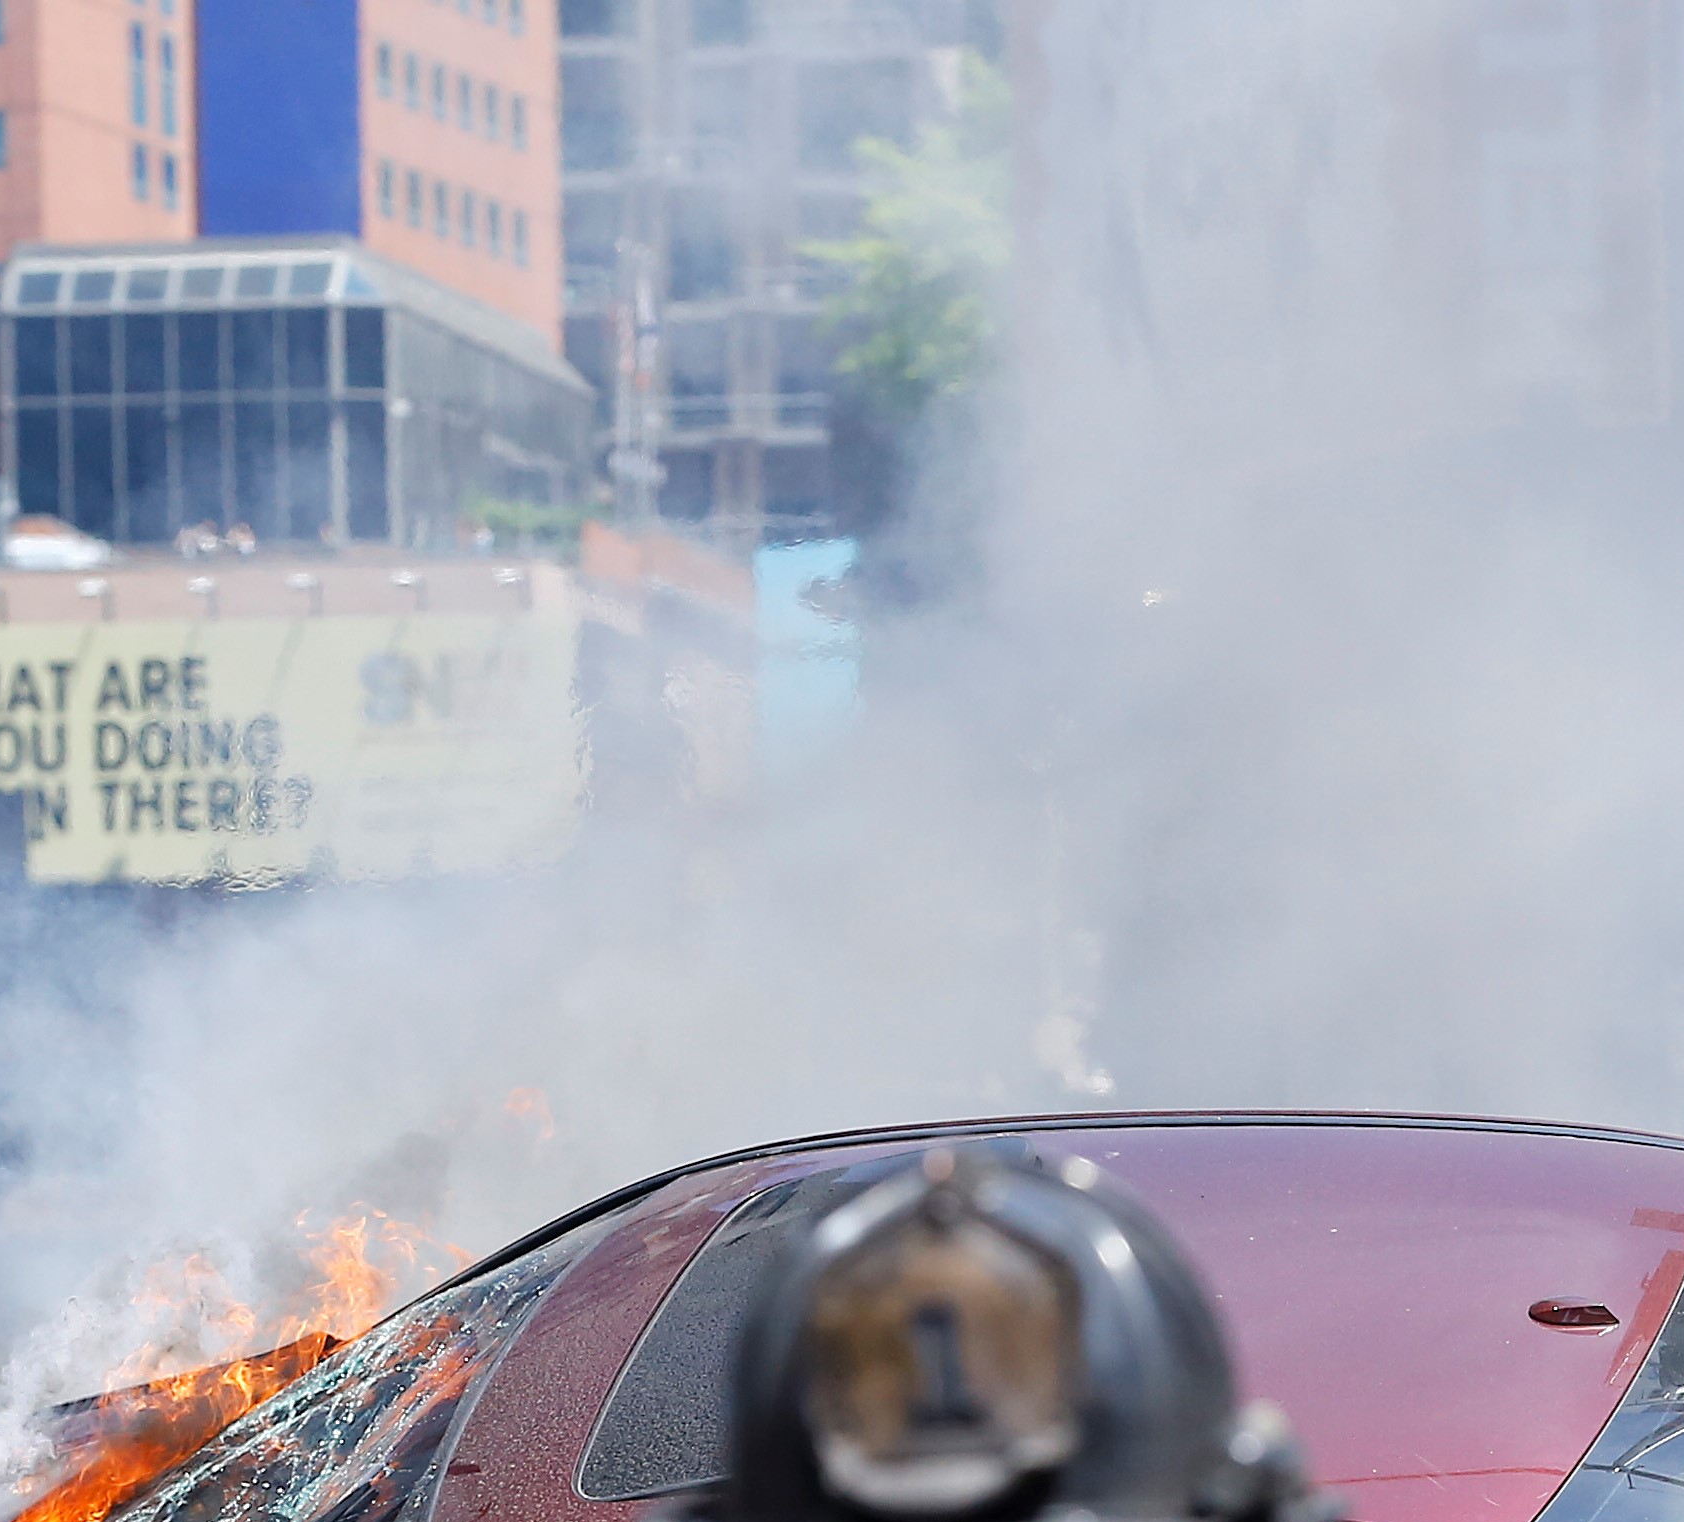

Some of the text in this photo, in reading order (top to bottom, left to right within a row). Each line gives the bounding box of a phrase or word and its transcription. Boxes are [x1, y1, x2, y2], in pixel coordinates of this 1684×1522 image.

[96, 656, 207, 711] ARE
[95, 714, 283, 774] DOING
[96, 775, 315, 834] THERE?
